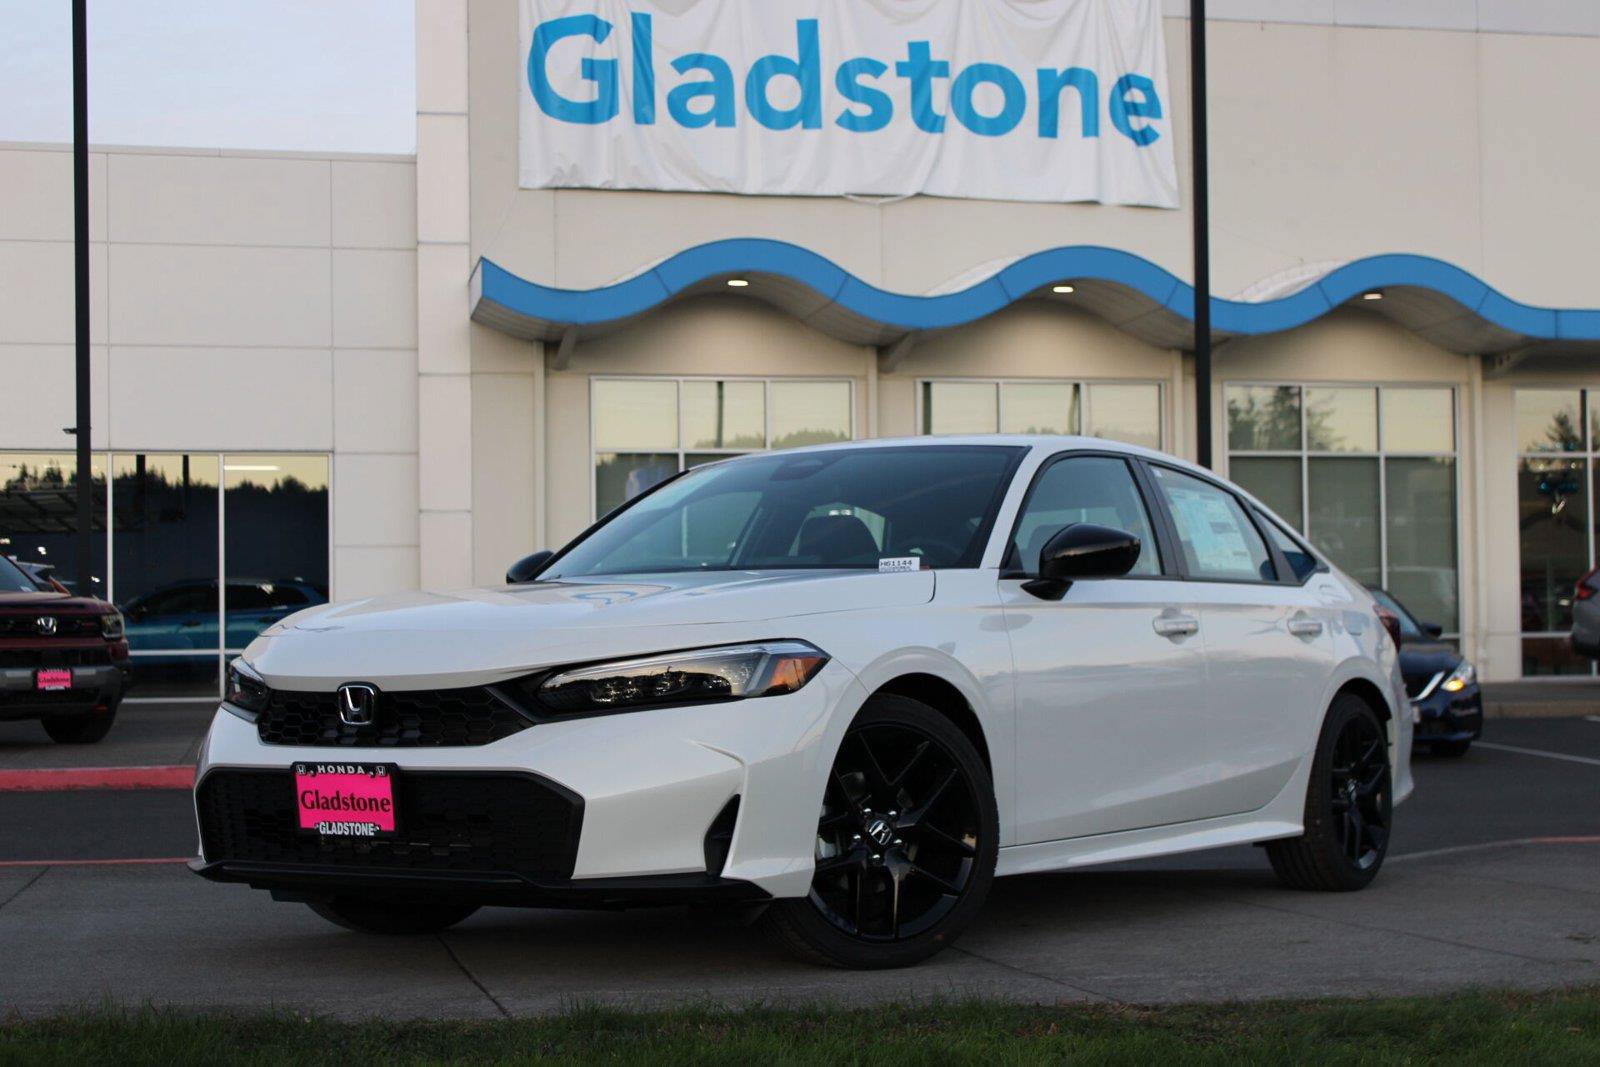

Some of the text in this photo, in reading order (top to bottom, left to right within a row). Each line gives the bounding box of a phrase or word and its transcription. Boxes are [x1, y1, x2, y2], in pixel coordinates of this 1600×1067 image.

[527, 12, 1162, 147] Gladstone
[317, 764, 366, 774] HONDA
[301, 789, 391, 812] Gladstone
[319, 821, 375, 836] GLADSTONE
